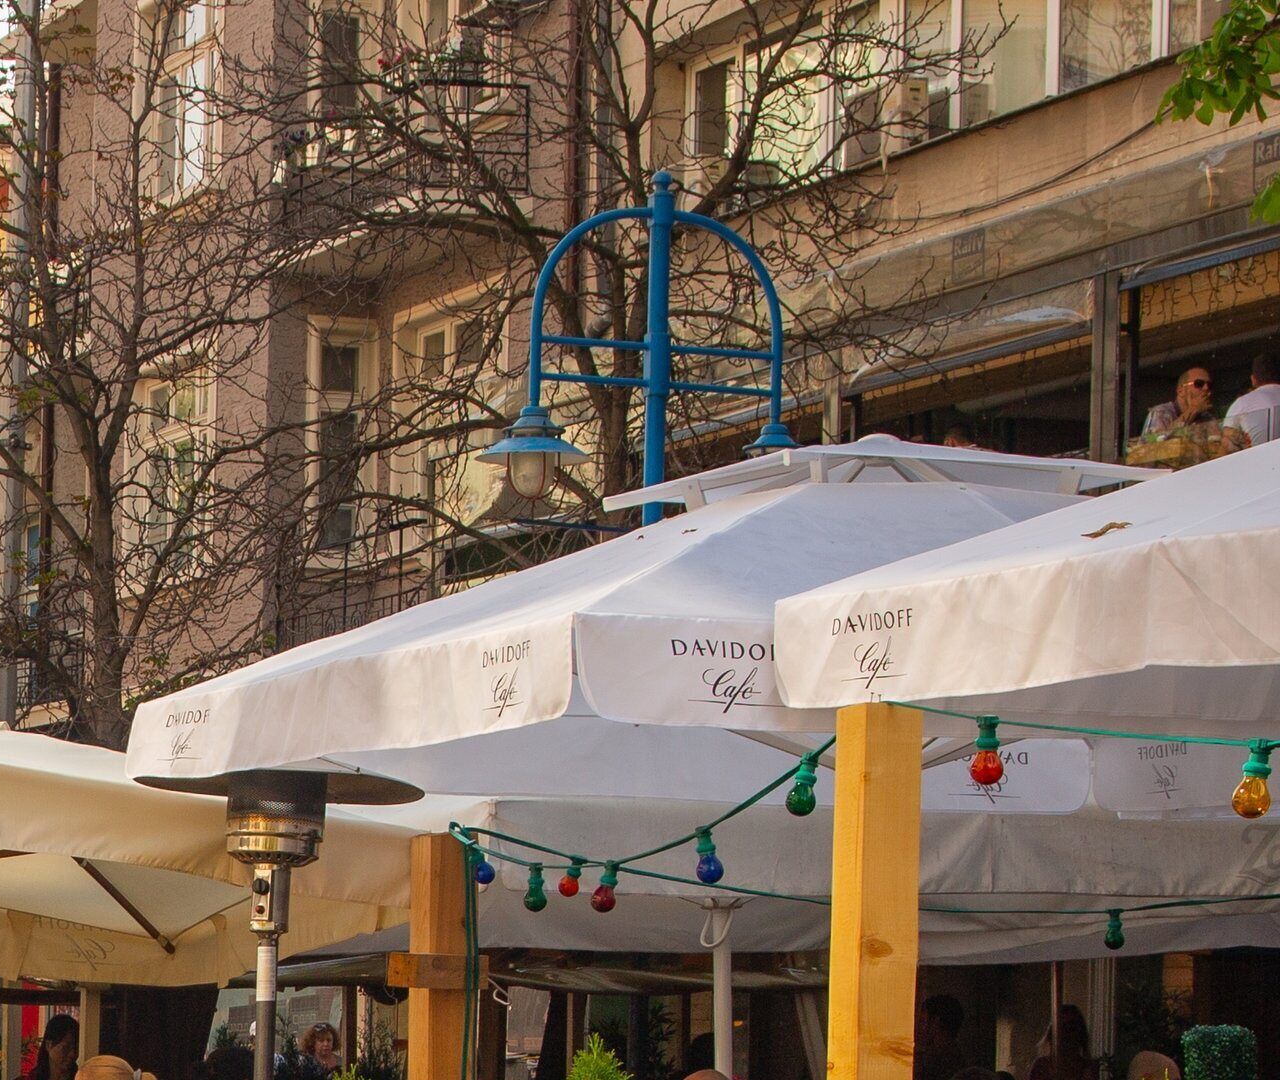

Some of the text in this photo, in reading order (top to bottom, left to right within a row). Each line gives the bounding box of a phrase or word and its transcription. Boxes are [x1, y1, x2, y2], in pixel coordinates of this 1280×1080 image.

[832, 608, 913, 636] DAVIDOFF
[482, 640, 531, 668] DAVIDOFF
[671, 639, 775, 662] DAVIDO
[854, 635, 894, 689] Café
[492, 667, 520, 717] Café
[702, 667, 761, 713] Café
